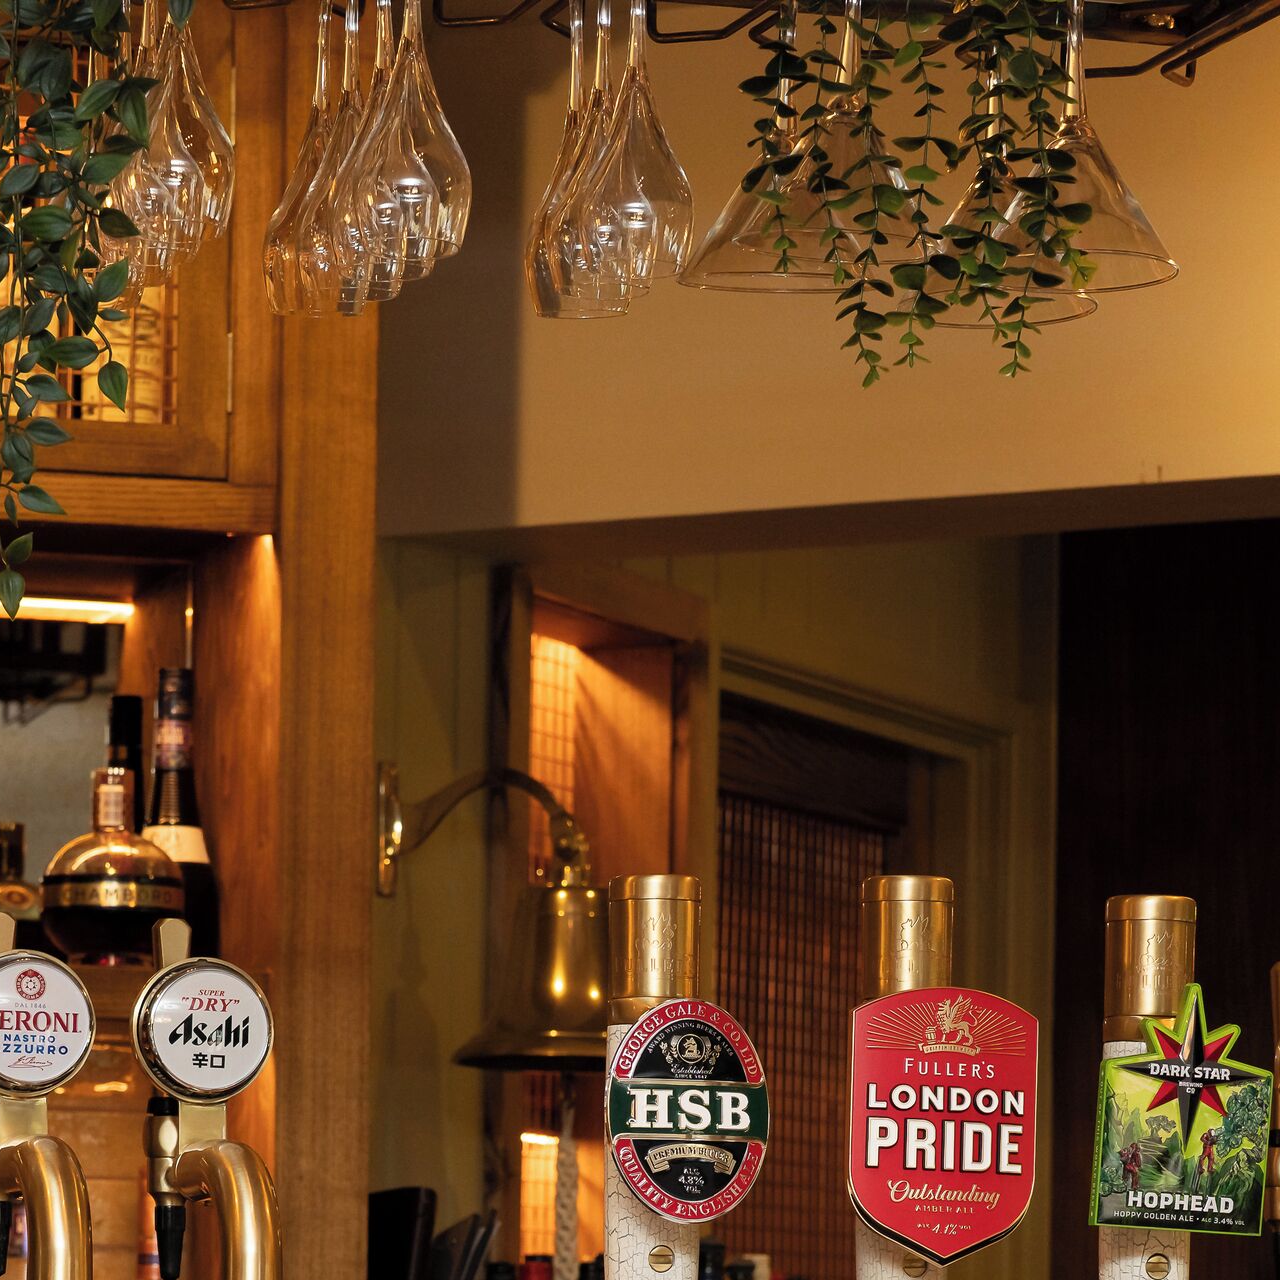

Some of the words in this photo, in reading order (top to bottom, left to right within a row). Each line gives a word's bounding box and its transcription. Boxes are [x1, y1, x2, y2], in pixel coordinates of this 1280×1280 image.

[198, 989, 225, 997] SUPER
[4, 1033, 56, 1043] NASTRO
[169, 1013, 250, 1048] Asahi
[619, 1013, 664, 1070] GEORGE
[665, 1003, 707, 1019] GALE
[710, 1011, 721, 1023] &
[723, 1022, 741, 1047] CO.
[740, 1045, 758, 1076] LTD
[647, 1033, 666, 1054] AWARD
[666, 1021, 696, 1035] WINNING
[192, 1052, 226, 1069] 辛口
[671, 1064, 713, 1075] Established
[904, 1058, 996, 1079] FULLER'S
[1148, 1062, 1191, 1078] DARK
[1194, 1066, 1231, 1081] STAR
[866, 1083, 1025, 1115] LONDON
[627, 1088, 751, 1132] HSB
[653, 1147, 697, 1161] PREMIUM
[865, 1116, 1024, 1175] PRIDE
[619, 1146, 673, 1210] QUALITY
[674, 1184, 743, 1217] ENGLISH
[739, 1152, 759, 1185] ALE
[678, 1175, 705, 1185] 4.8%
[887, 1180, 1001, 1210] Outstanding
[1126, 1190, 1234, 1215] HOPHEAD
[915, 1204, 953, 1213] AMBER
[955, 1206, 976, 1214] ALE
[1113, 1210, 1142, 1219] HOPPY
[1143, 1212, 1177, 1221] GOLDEN
[1179, 1214, 1194, 1222] ALE
[1213, 1217, 1234, 1225] 3.4%
[932, 1223, 958, 1235] 4.1%
